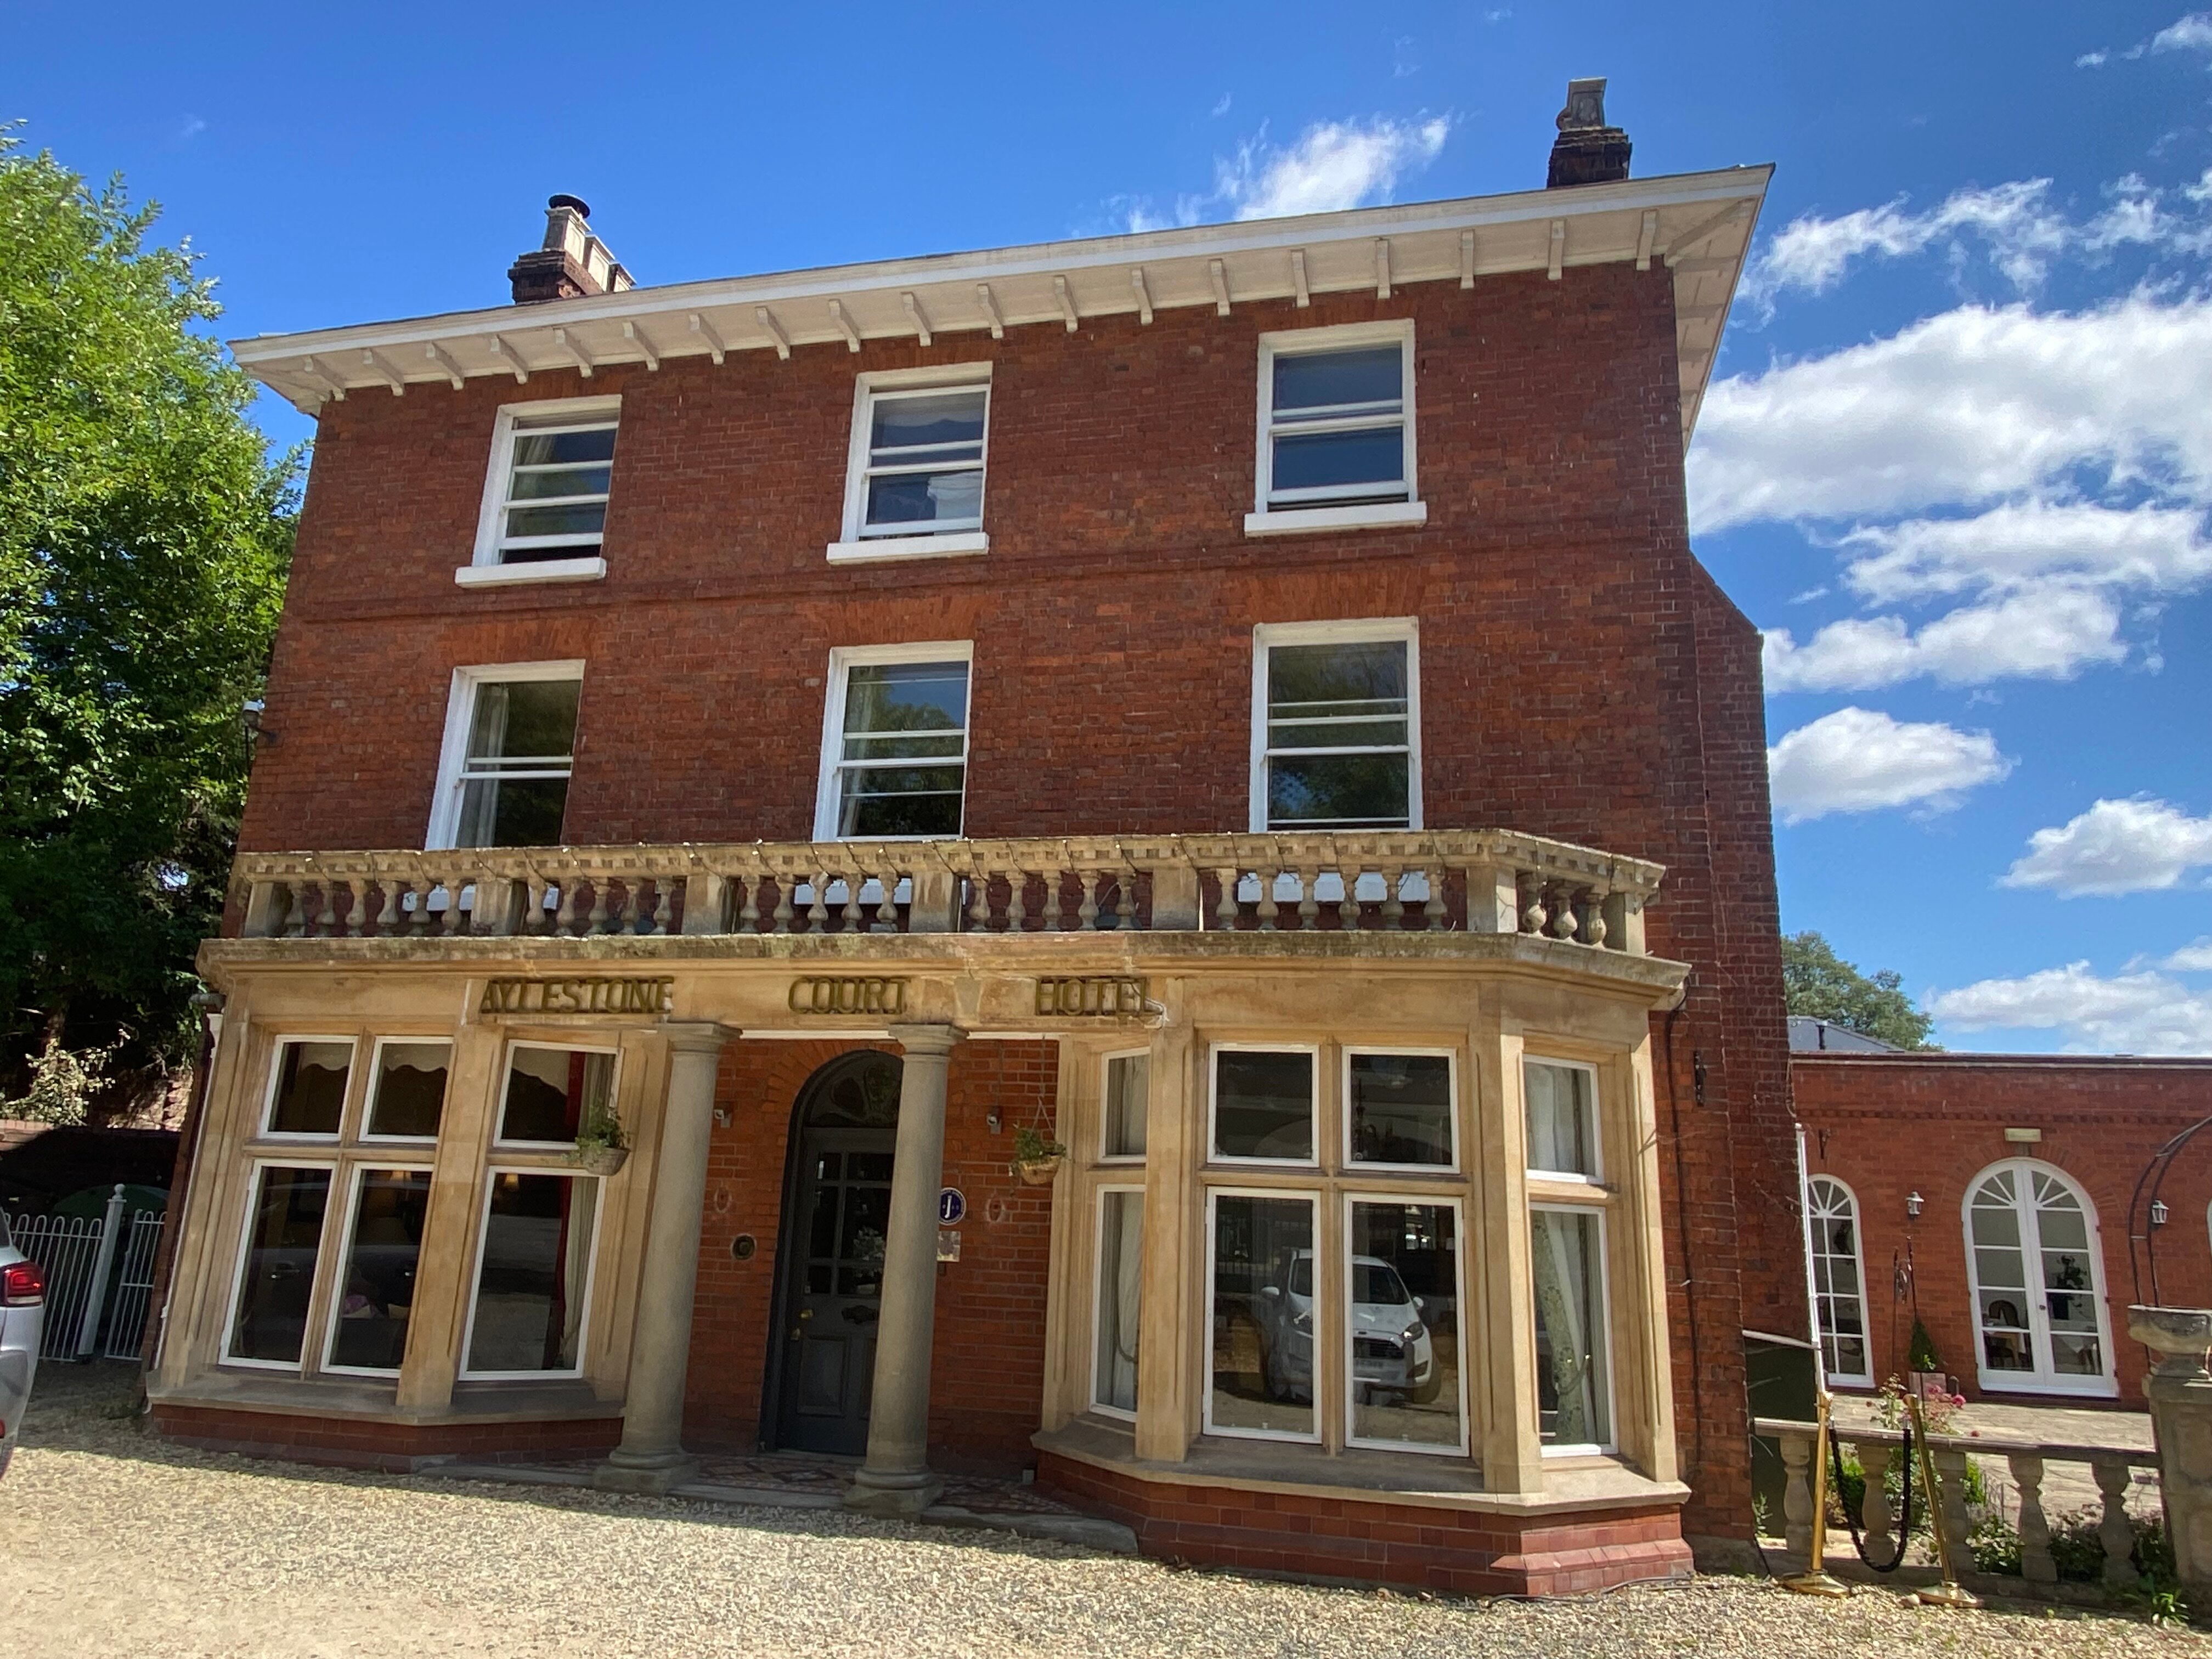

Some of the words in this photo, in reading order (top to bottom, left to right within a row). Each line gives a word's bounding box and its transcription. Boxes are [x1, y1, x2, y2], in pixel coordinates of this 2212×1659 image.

[480, 977, 674, 1014] AYLESTONE
[788, 975, 910, 1014] COURT
[1036, 976, 1161, 1015] HOTEL
